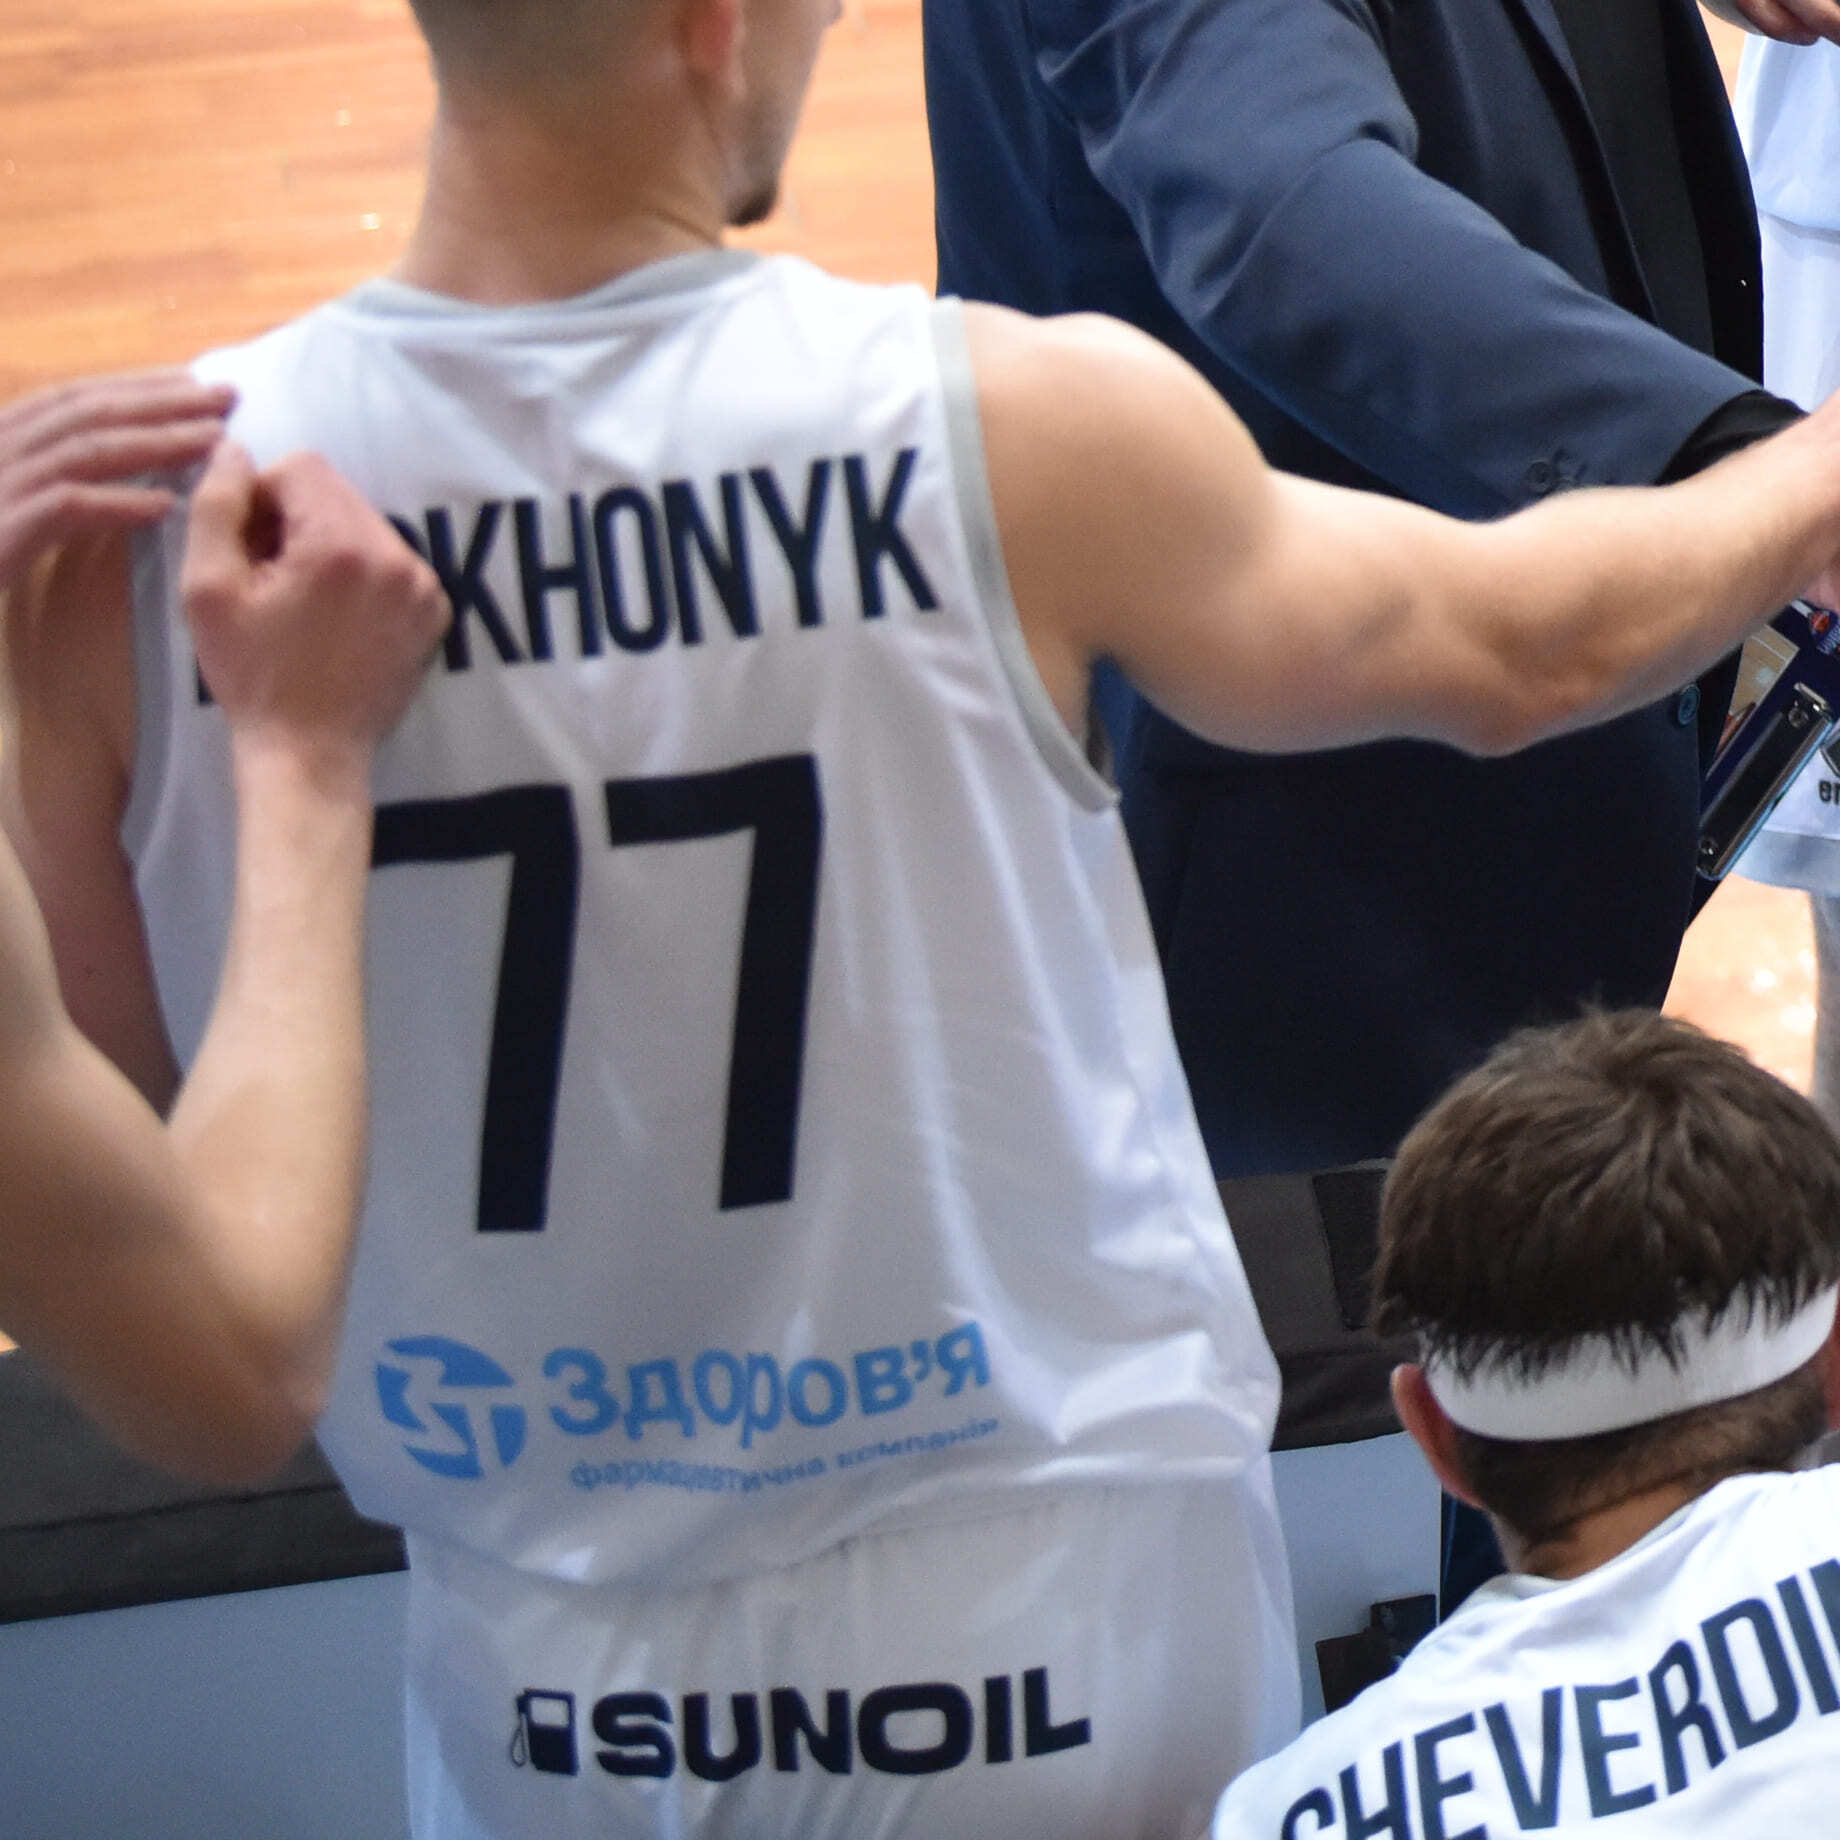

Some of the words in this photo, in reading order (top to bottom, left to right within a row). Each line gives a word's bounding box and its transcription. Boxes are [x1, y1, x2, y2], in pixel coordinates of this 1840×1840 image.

[196, 446, 941, 705] KHONYK
[369, 751, 825, 1233] 77
[591, 1664, 1093, 1782] SUNOIL
